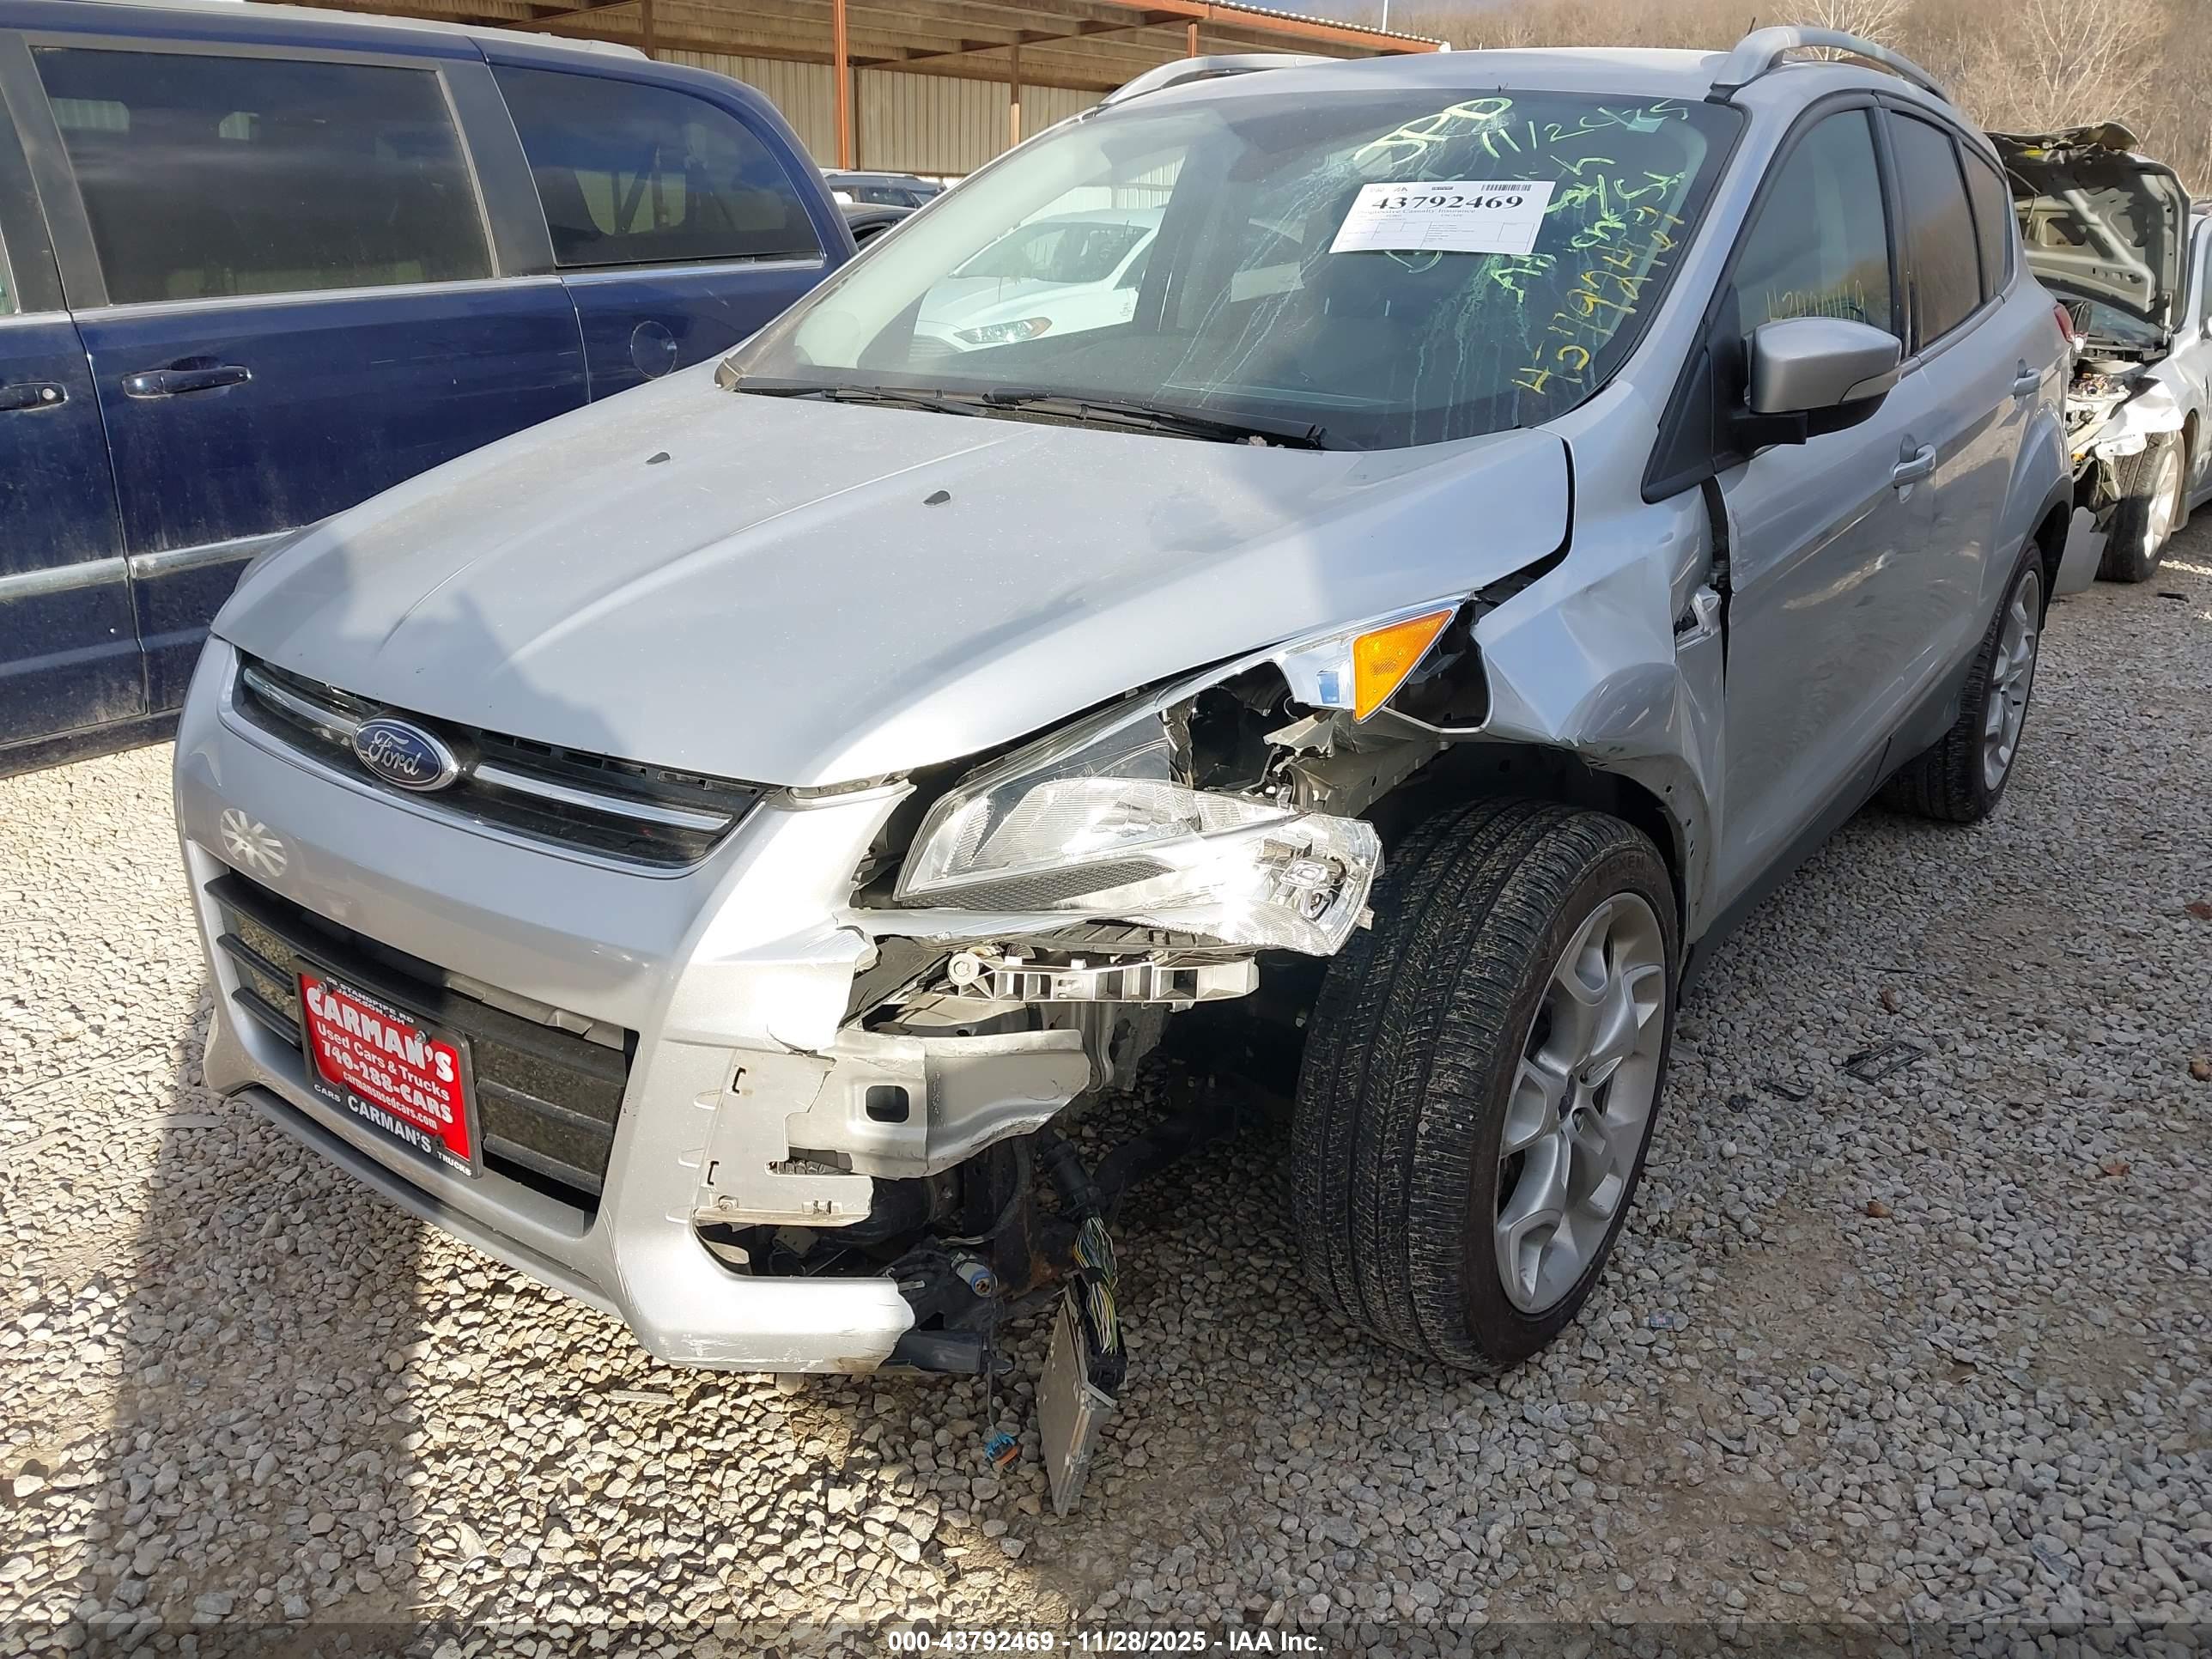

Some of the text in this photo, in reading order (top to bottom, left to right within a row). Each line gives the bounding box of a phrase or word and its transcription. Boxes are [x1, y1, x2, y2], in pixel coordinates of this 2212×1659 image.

[1371, 195, 1522, 209] 43792469
[368, 730, 422, 776] Ford
[340, 983, 397, 1016] STANDPIPE
[398, 1012, 414, 1024] RD
[388, 1014, 405, 1026] OH
[307, 987, 454, 1083] CARMAN'S
[316, 1020, 451, 1102] Used Cars & Trucks
[321, 1039, 454, 1124] 740-288-CARS
[343, 1071, 438, 1131] carmansusedcars.com
[313, 1083, 472, 1177] CARS CARMAN'S TRUCKS
